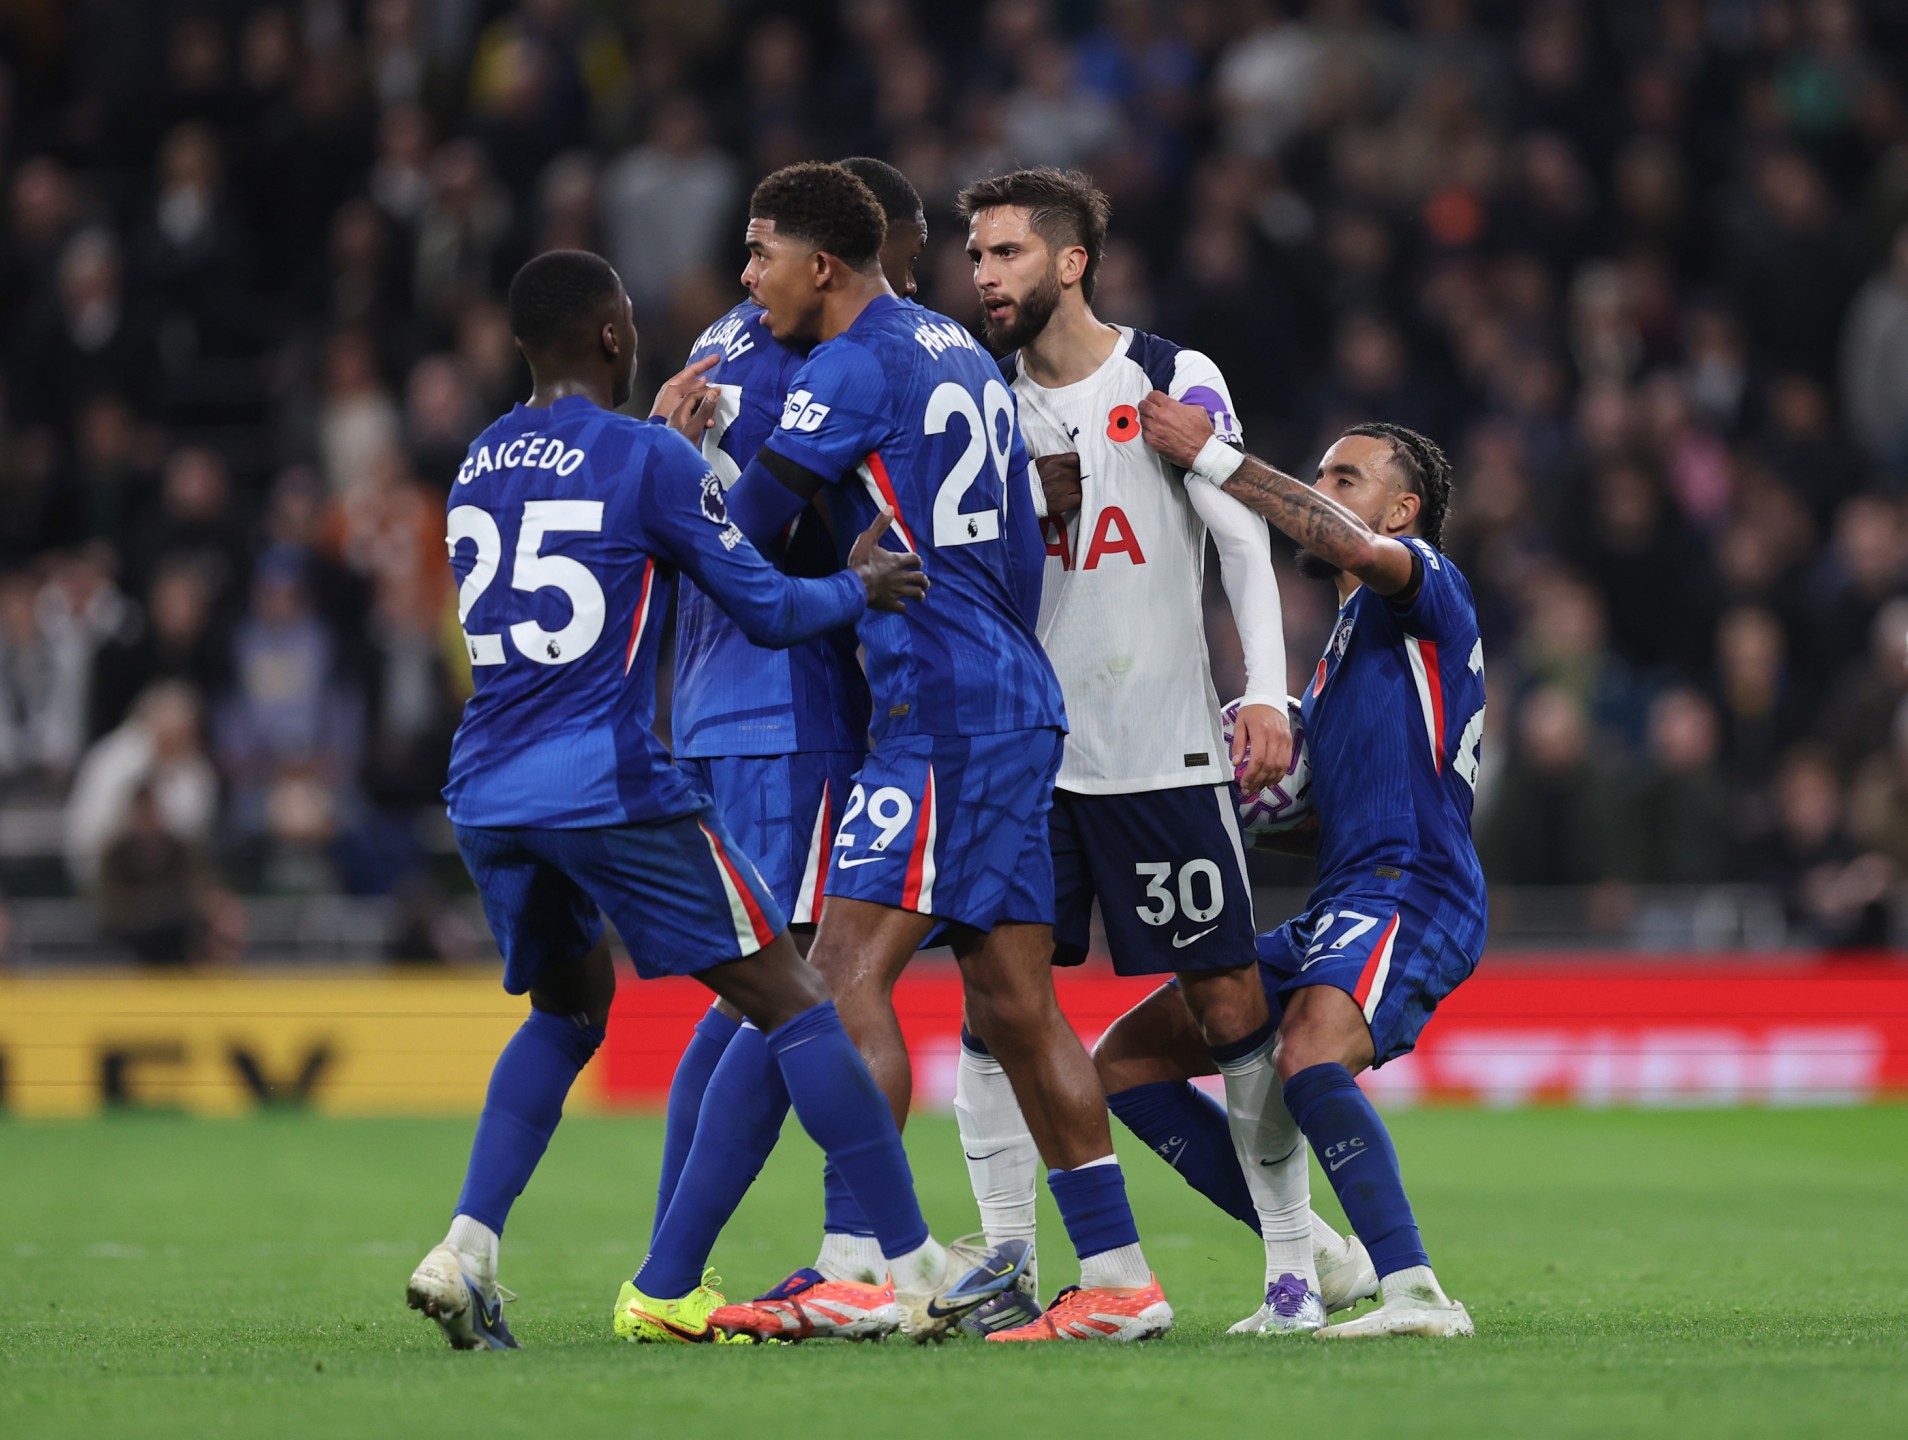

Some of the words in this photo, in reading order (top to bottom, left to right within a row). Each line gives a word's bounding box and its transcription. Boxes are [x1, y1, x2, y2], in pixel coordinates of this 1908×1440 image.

[914, 322, 980, 361] FOFANA
[458, 437, 585, 485] CAICEDO
[924, 379, 1016, 548] 29
[1040, 505, 1147, 572] AA
[445, 500, 606, 666] 25
[834, 783, 914, 852] 29
[1135, 858, 1225, 927] 30
[1304, 910, 1379, 960] 27
[1155, 1136, 1183, 1157] FC
[1324, 1137, 1364, 1158] CFC
